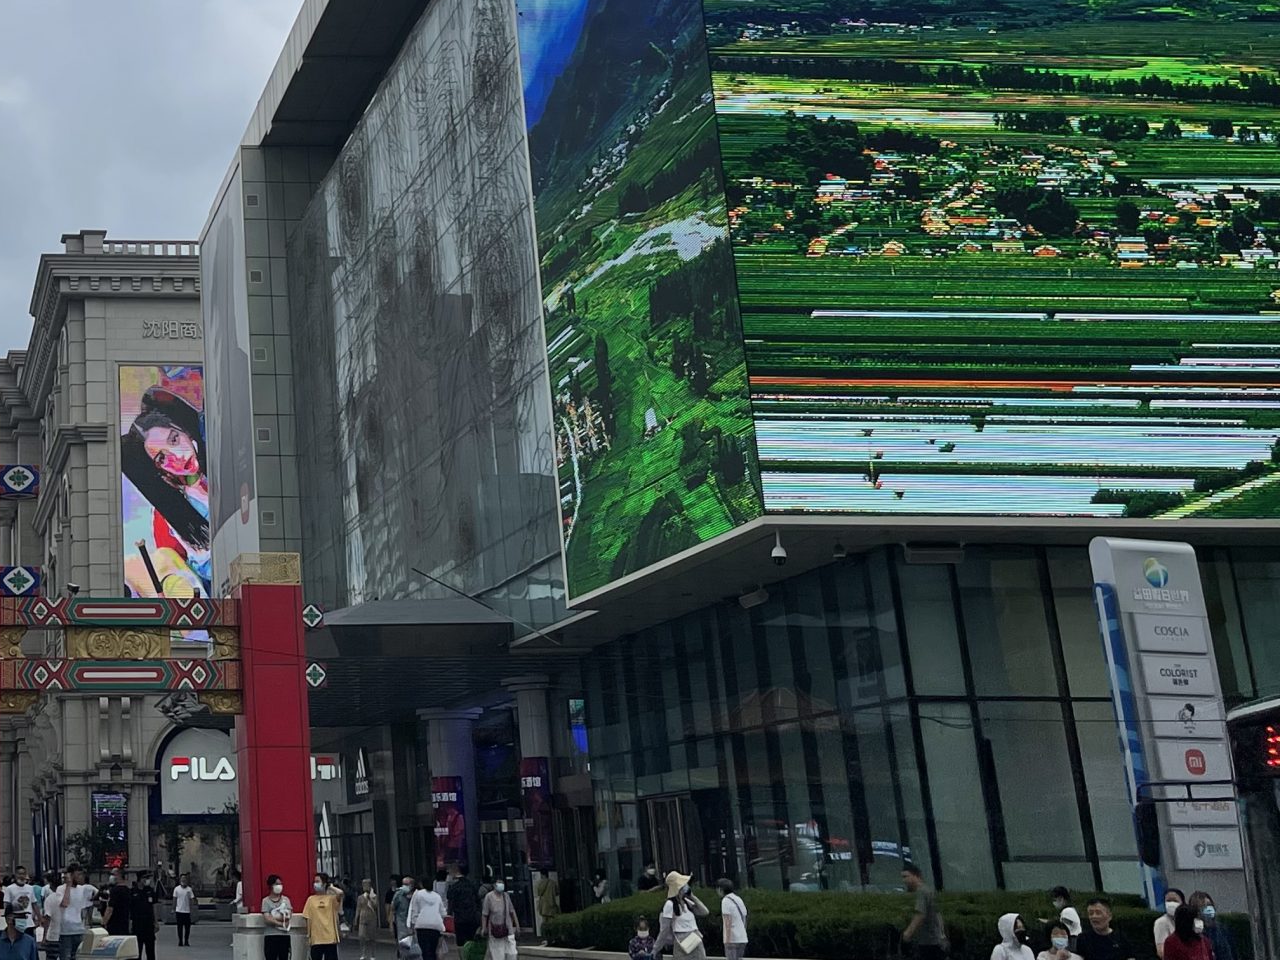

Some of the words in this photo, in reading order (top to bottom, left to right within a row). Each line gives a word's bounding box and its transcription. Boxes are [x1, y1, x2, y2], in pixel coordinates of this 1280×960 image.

[1154, 626, 1190, 637] COSCIA
[1160, 668, 1198, 679] COLORIST
[171, 756, 236, 781] FILA
